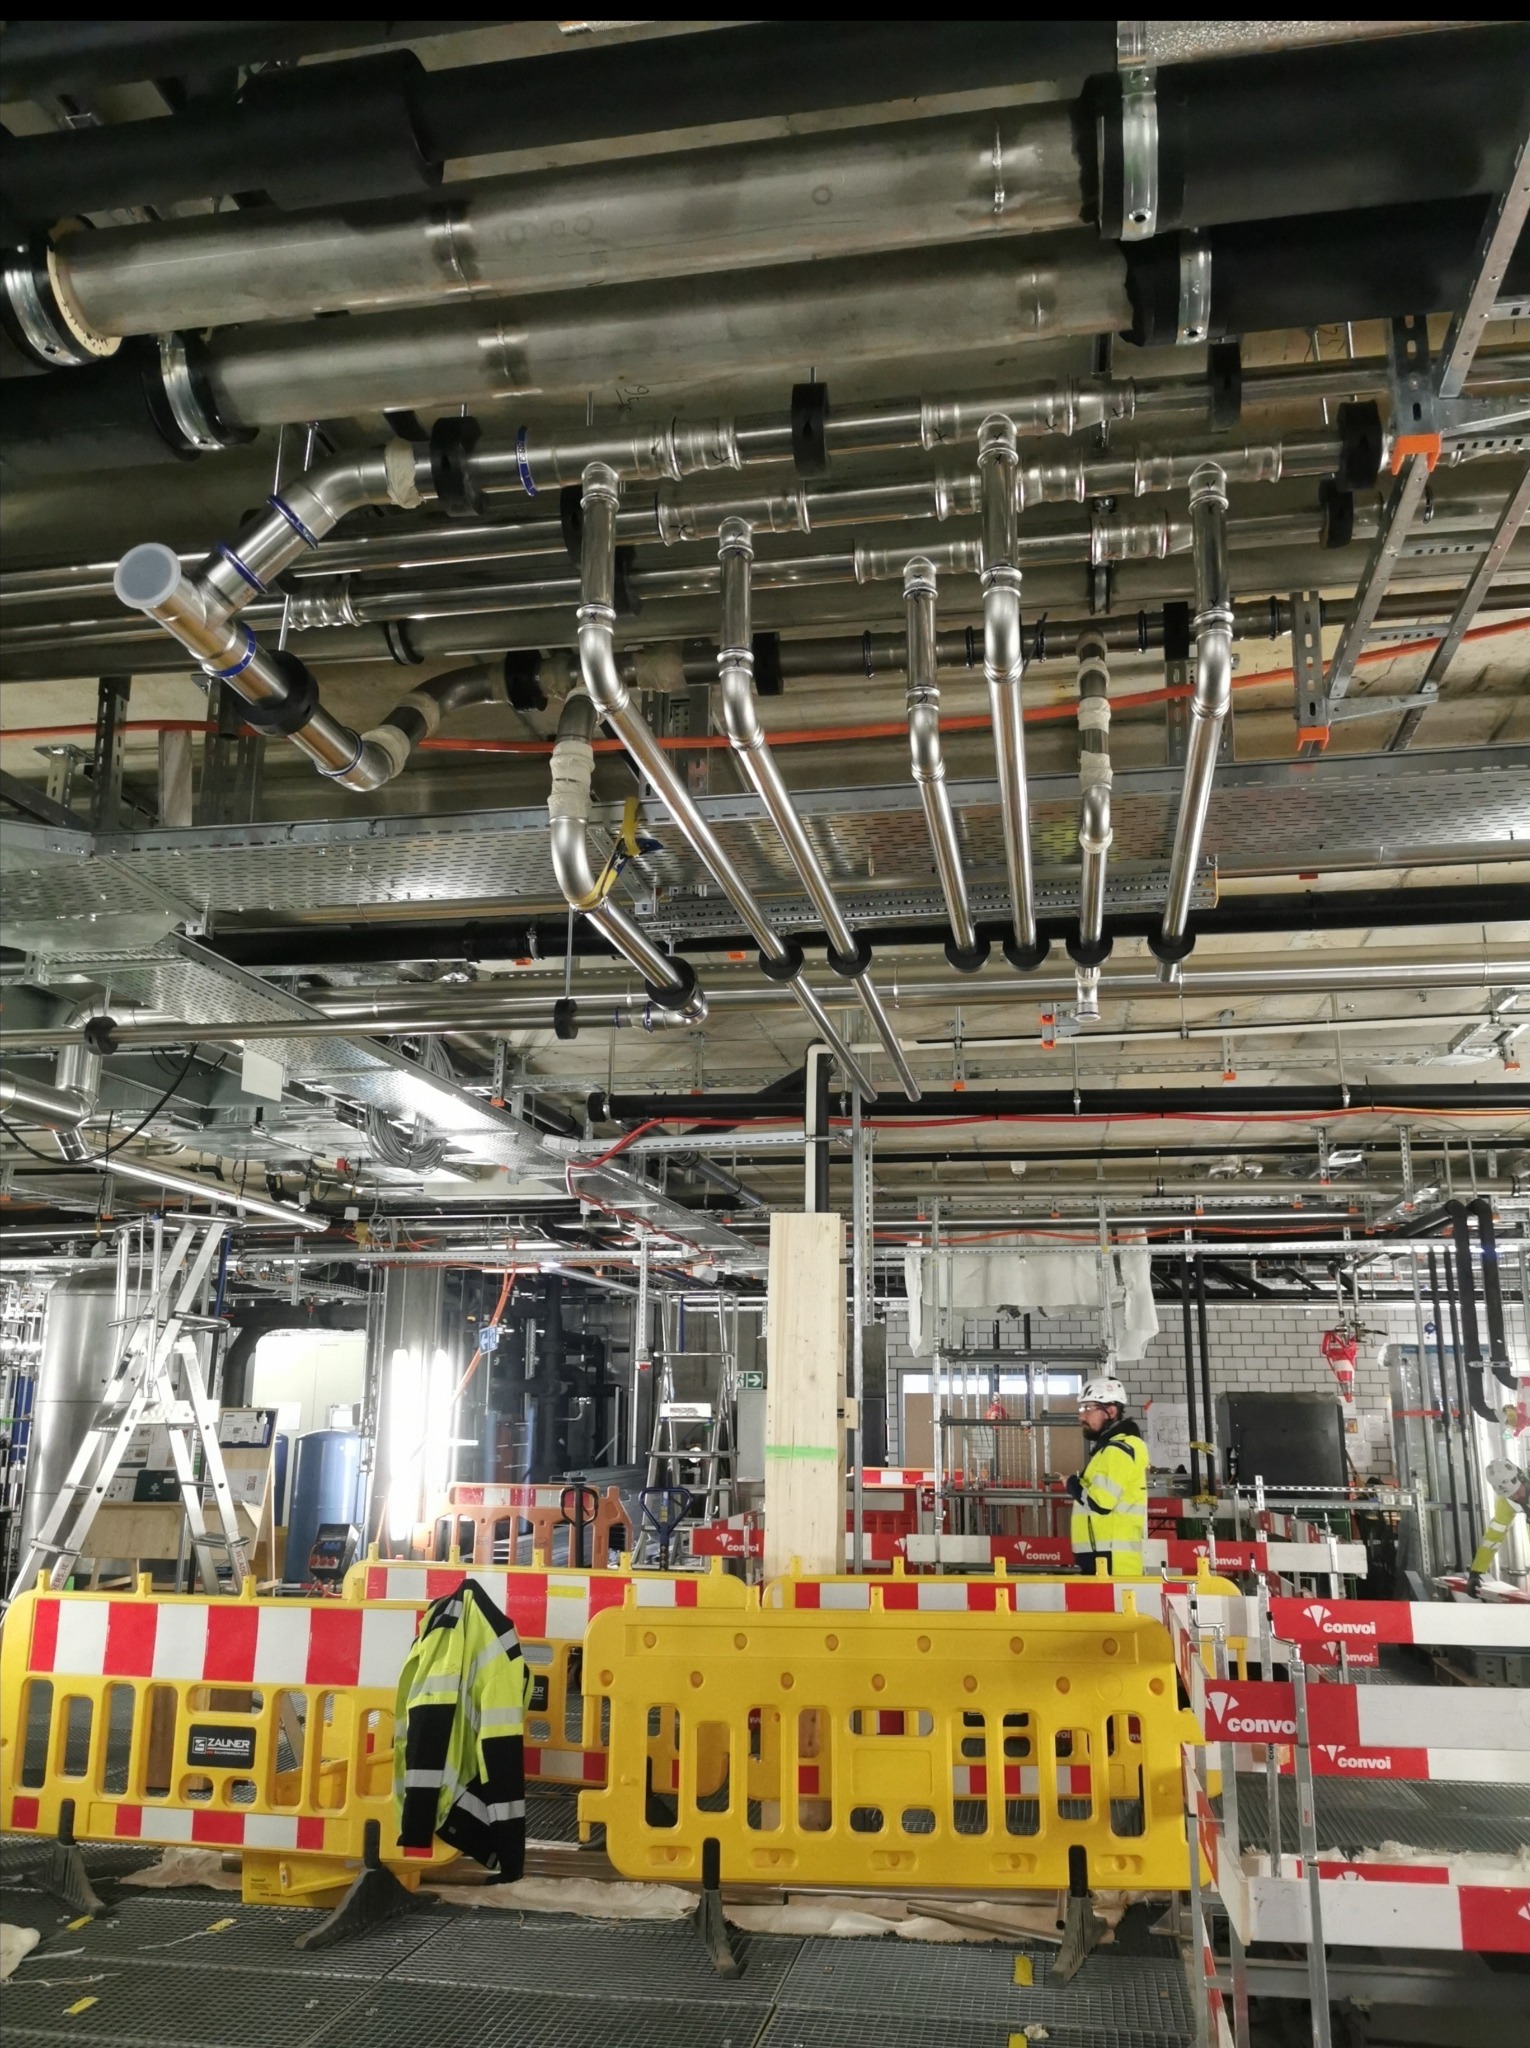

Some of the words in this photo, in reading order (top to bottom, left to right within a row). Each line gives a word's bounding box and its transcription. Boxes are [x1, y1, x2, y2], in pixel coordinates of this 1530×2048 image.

[727, 1543, 759, 1552] conoi
[1026, 1552, 1060, 1560] convoi
[1214, 1556, 1242, 1566] onvoi
[1322, 1621, 1376, 1634] convoi
[1227, 1717, 1297, 1734] convo
[207, 1738, 250, 1748] ZAUNER
[1337, 1756, 1391, 1770] convoi
